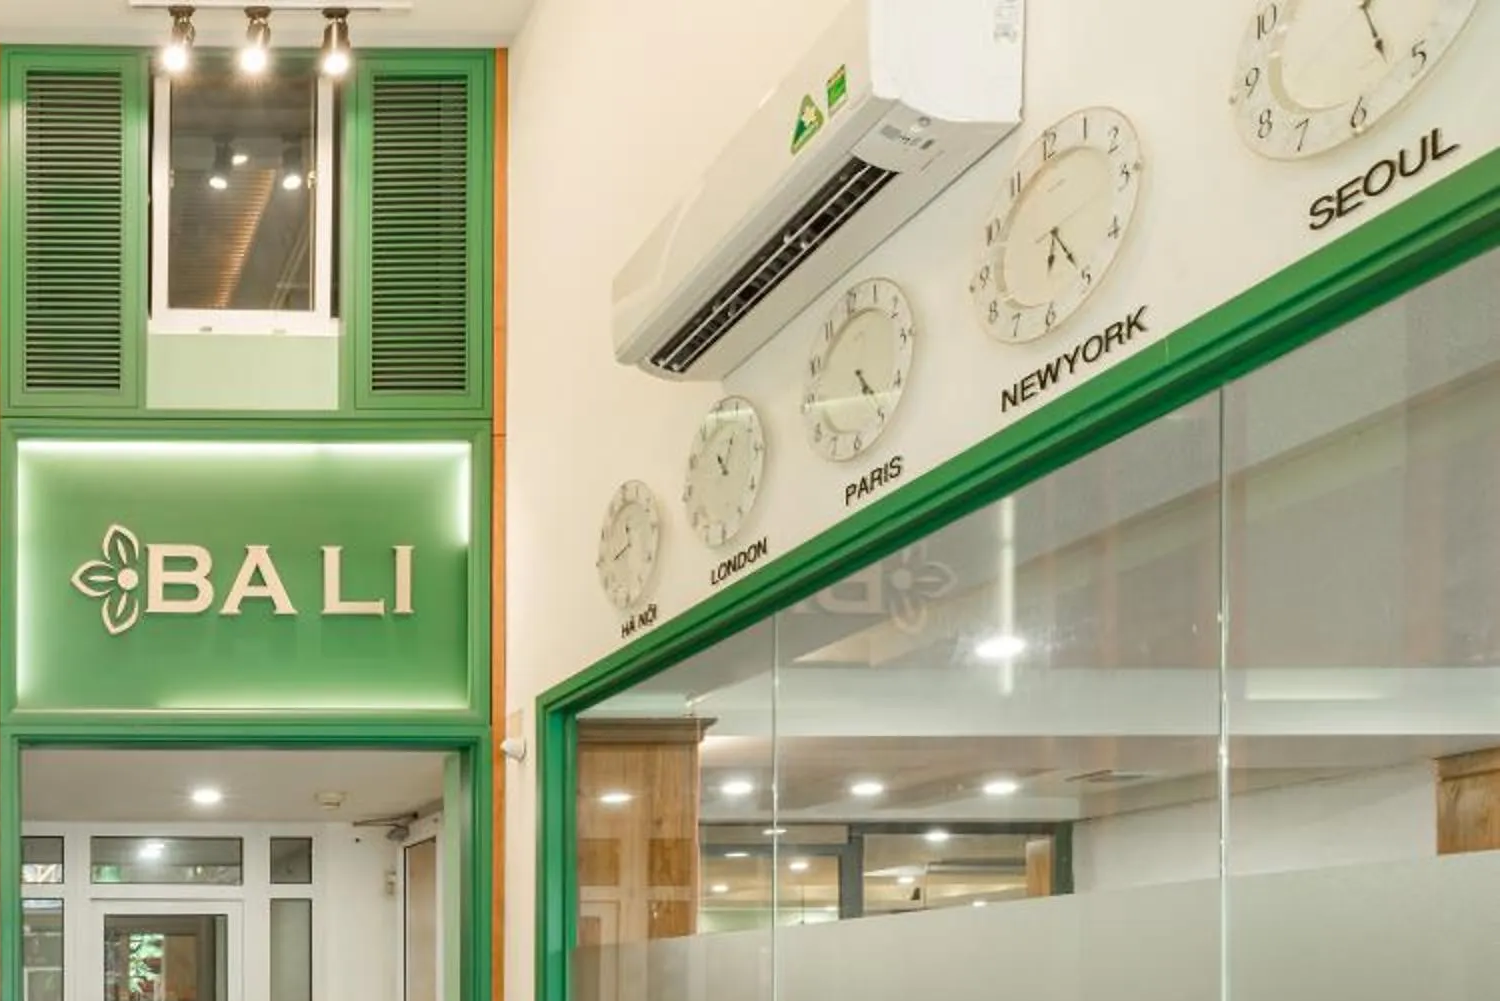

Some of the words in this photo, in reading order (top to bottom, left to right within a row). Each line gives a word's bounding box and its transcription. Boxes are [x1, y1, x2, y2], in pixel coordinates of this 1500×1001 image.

[1256, 4, 1278, 40] 10
[1411, 40, 1427, 77] 5
[1244, 66, 1259, 98] 9
[1257, 108, 1273, 139] 8
[1350, 96, 1367, 128] 6
[1294, 117, 1309, 152] 7
[1308, 127, 1461, 231] SEOUL
[1001, 305, 1149, 413] NEWYORK
[845, 455, 903, 506] PARIS
[144, 543, 415, 615] BALI
[710, 537, 769, 586] LONDON
